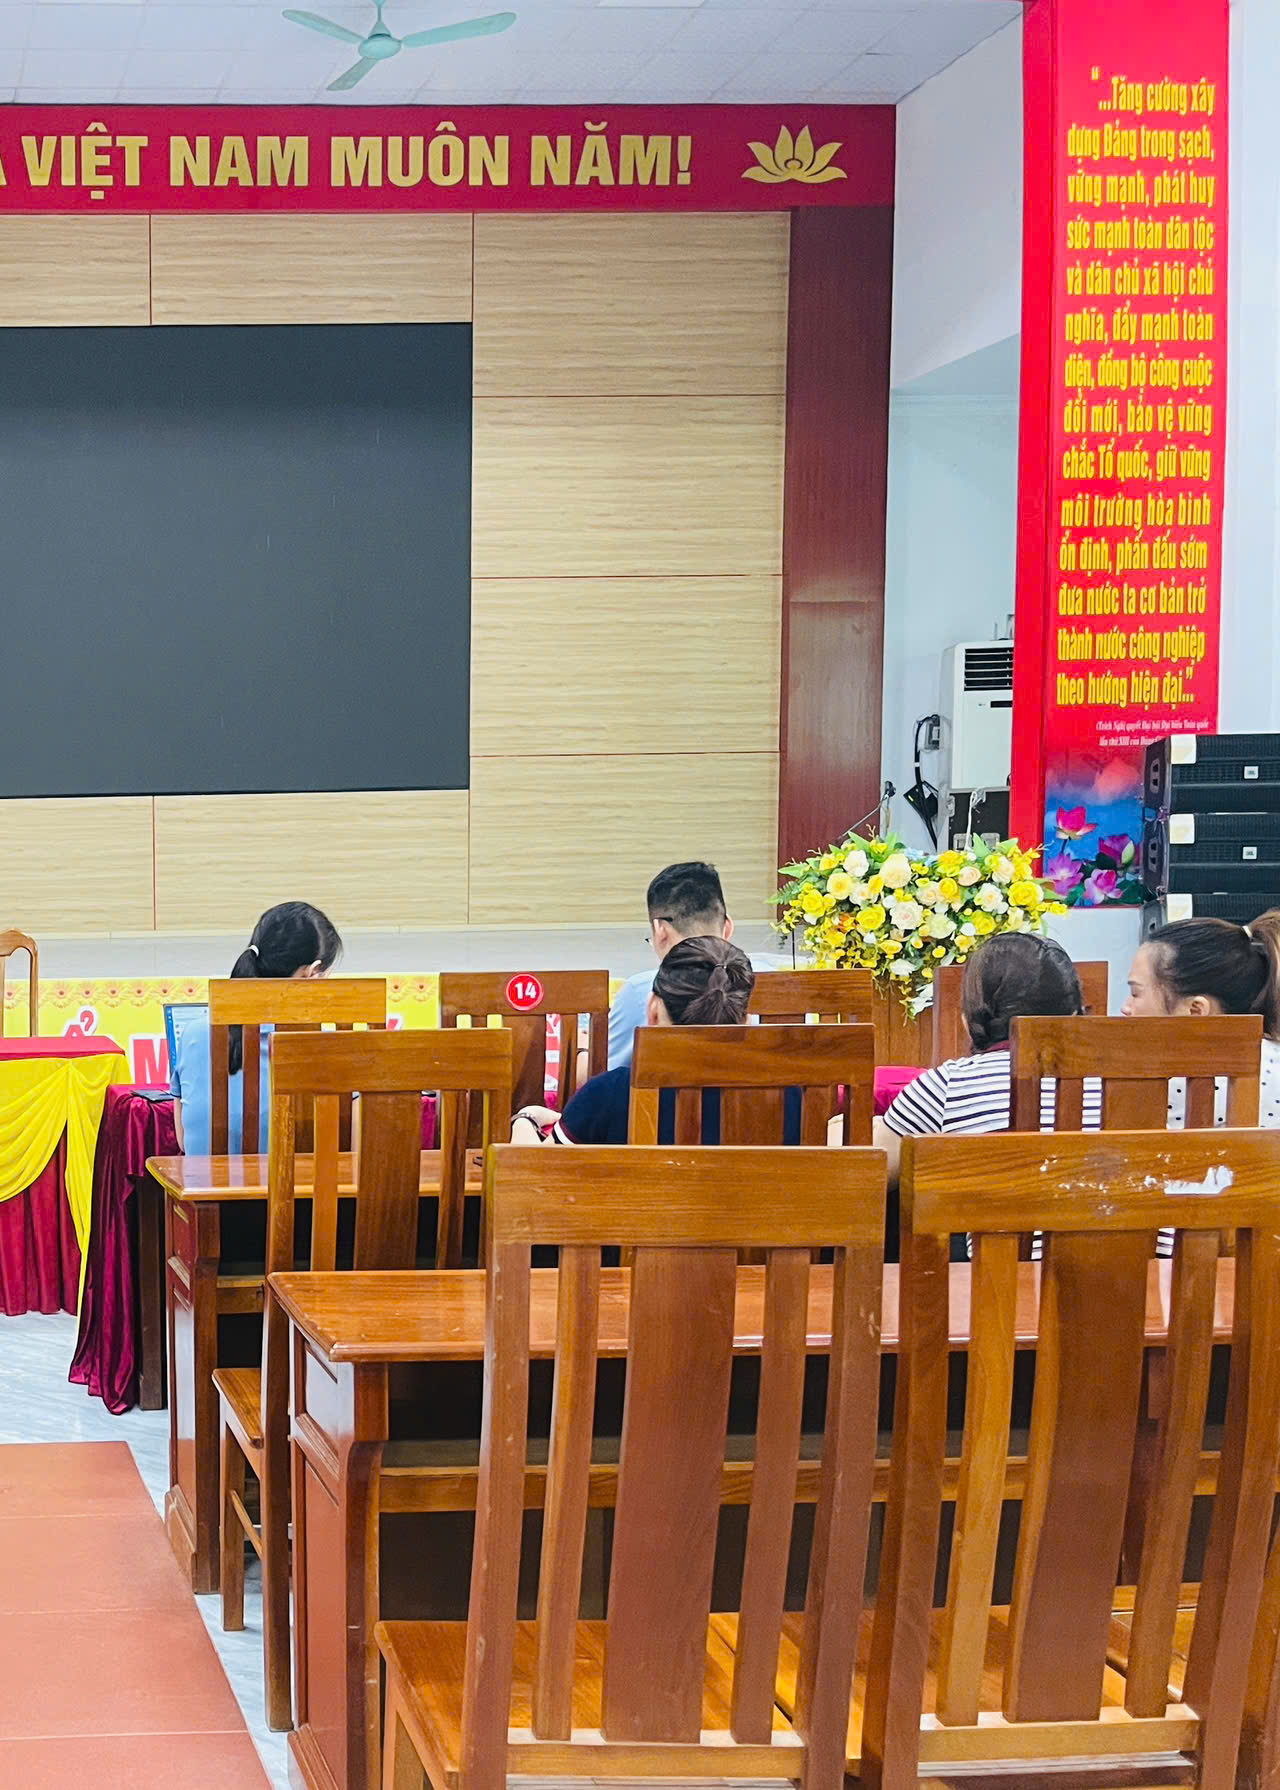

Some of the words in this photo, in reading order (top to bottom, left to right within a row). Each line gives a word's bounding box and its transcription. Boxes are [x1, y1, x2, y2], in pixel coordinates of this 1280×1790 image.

[1191, 77, 1215, 116] xây
[22, 121, 147, 199] VIỆT
[170, 135, 309, 186] NAM
[330, 121, 509, 186] MUÔN
[530, 120, 692, 187] NĂM!
[1068, 122, 1100, 164] dựng
[1104, 118, 1137, 161] Đảng
[1140, 124, 1176, 161] trong
[1179, 124, 1214, 165] sạch,
[1068, 169, 1102, 207] vững
[1106, 170, 1150, 210] mạnh,
[1154, 170, 1185, 208] phát
[1190, 170, 1215, 208] huy
[1067, 214, 1090, 249] sức
[1094, 215, 1130, 256] mạnh
[1134, 215, 1162, 249] toàn
[1166, 215, 1190, 249] dân
[1193, 215, 1215, 256] tộc
[1067, 260, 1082, 295] và
[1086, 261, 1111, 295] dân
[1115, 257, 1139, 295] chủ
[1143, 261, 1160, 295] xã
[1164, 261, 1185, 302] hội
[1189, 257, 1213, 295] chủ
[1065, 307, 1108, 345] nghĩa,
[1141, 307, 1178, 348] mạnh
[1183, 306, 1213, 341] toàn
[1065, 353, 1095, 391] diện,
[1131, 352, 1146, 393] bộ
[1150, 352, 1180, 391] công
[1182, 352, 1212, 394] cuộc
[1091, 398, 1122, 436] mới,
[1127, 395, 1153, 432] bảo
[1158, 398, 1173, 439] vệ
[1178, 398, 1212, 436] vững
[1063, 438, 1095, 478] chắc
[1098, 438, 1115, 478] Tổ
[1117, 440, 1152, 482] quốc,
[1156, 445, 1177, 481] giữ
[1180, 444, 1211, 481] vững
[1061, 493, 1090, 527] môi
[1094, 492, 1143, 531] trường
[1080, 537, 1112, 576] định,
[1116, 530, 1148, 575] phấn
[1153, 530, 1176, 569] đấu
[1180, 534, 1207, 569] sớm
[1059, 582, 1082, 616] đưa
[1087, 581, 1119, 615] nước
[1123, 582, 1136, 615] ta
[1140, 585, 1156, 614] cơ
[1160, 576, 1184, 614] bản
[1188, 576, 1206, 614] trở
[1058, 626, 1092, 660] thành
[1096, 625, 1126, 659] nước
[1129, 625, 1160, 663] công
[1163, 625, 1205, 665] nghiệp
[1057, 672, 1084, 705] theo
[1088, 670, 1128, 708] hướng
[1131, 670, 1158, 711] hiện
[515, 981, 537, 1000] 14
